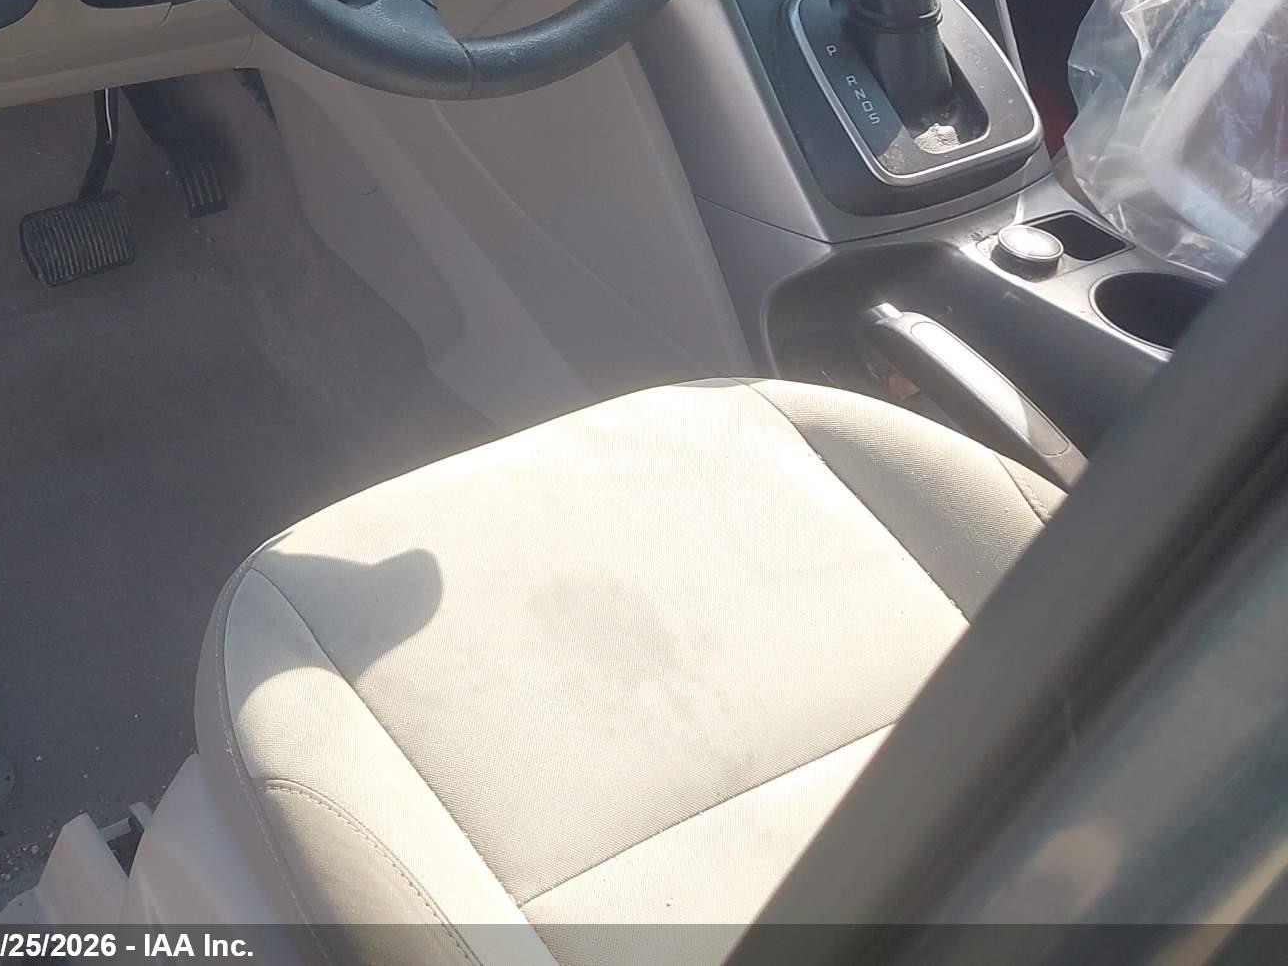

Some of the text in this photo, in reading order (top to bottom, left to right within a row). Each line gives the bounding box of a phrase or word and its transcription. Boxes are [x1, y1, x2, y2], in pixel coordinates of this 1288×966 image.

[826, 44, 838, 56] P
[846, 75, 858, 87] R
[854, 88, 867, 100] N
[861, 100, 874, 112] D
[869, 112, 881, 125] S
